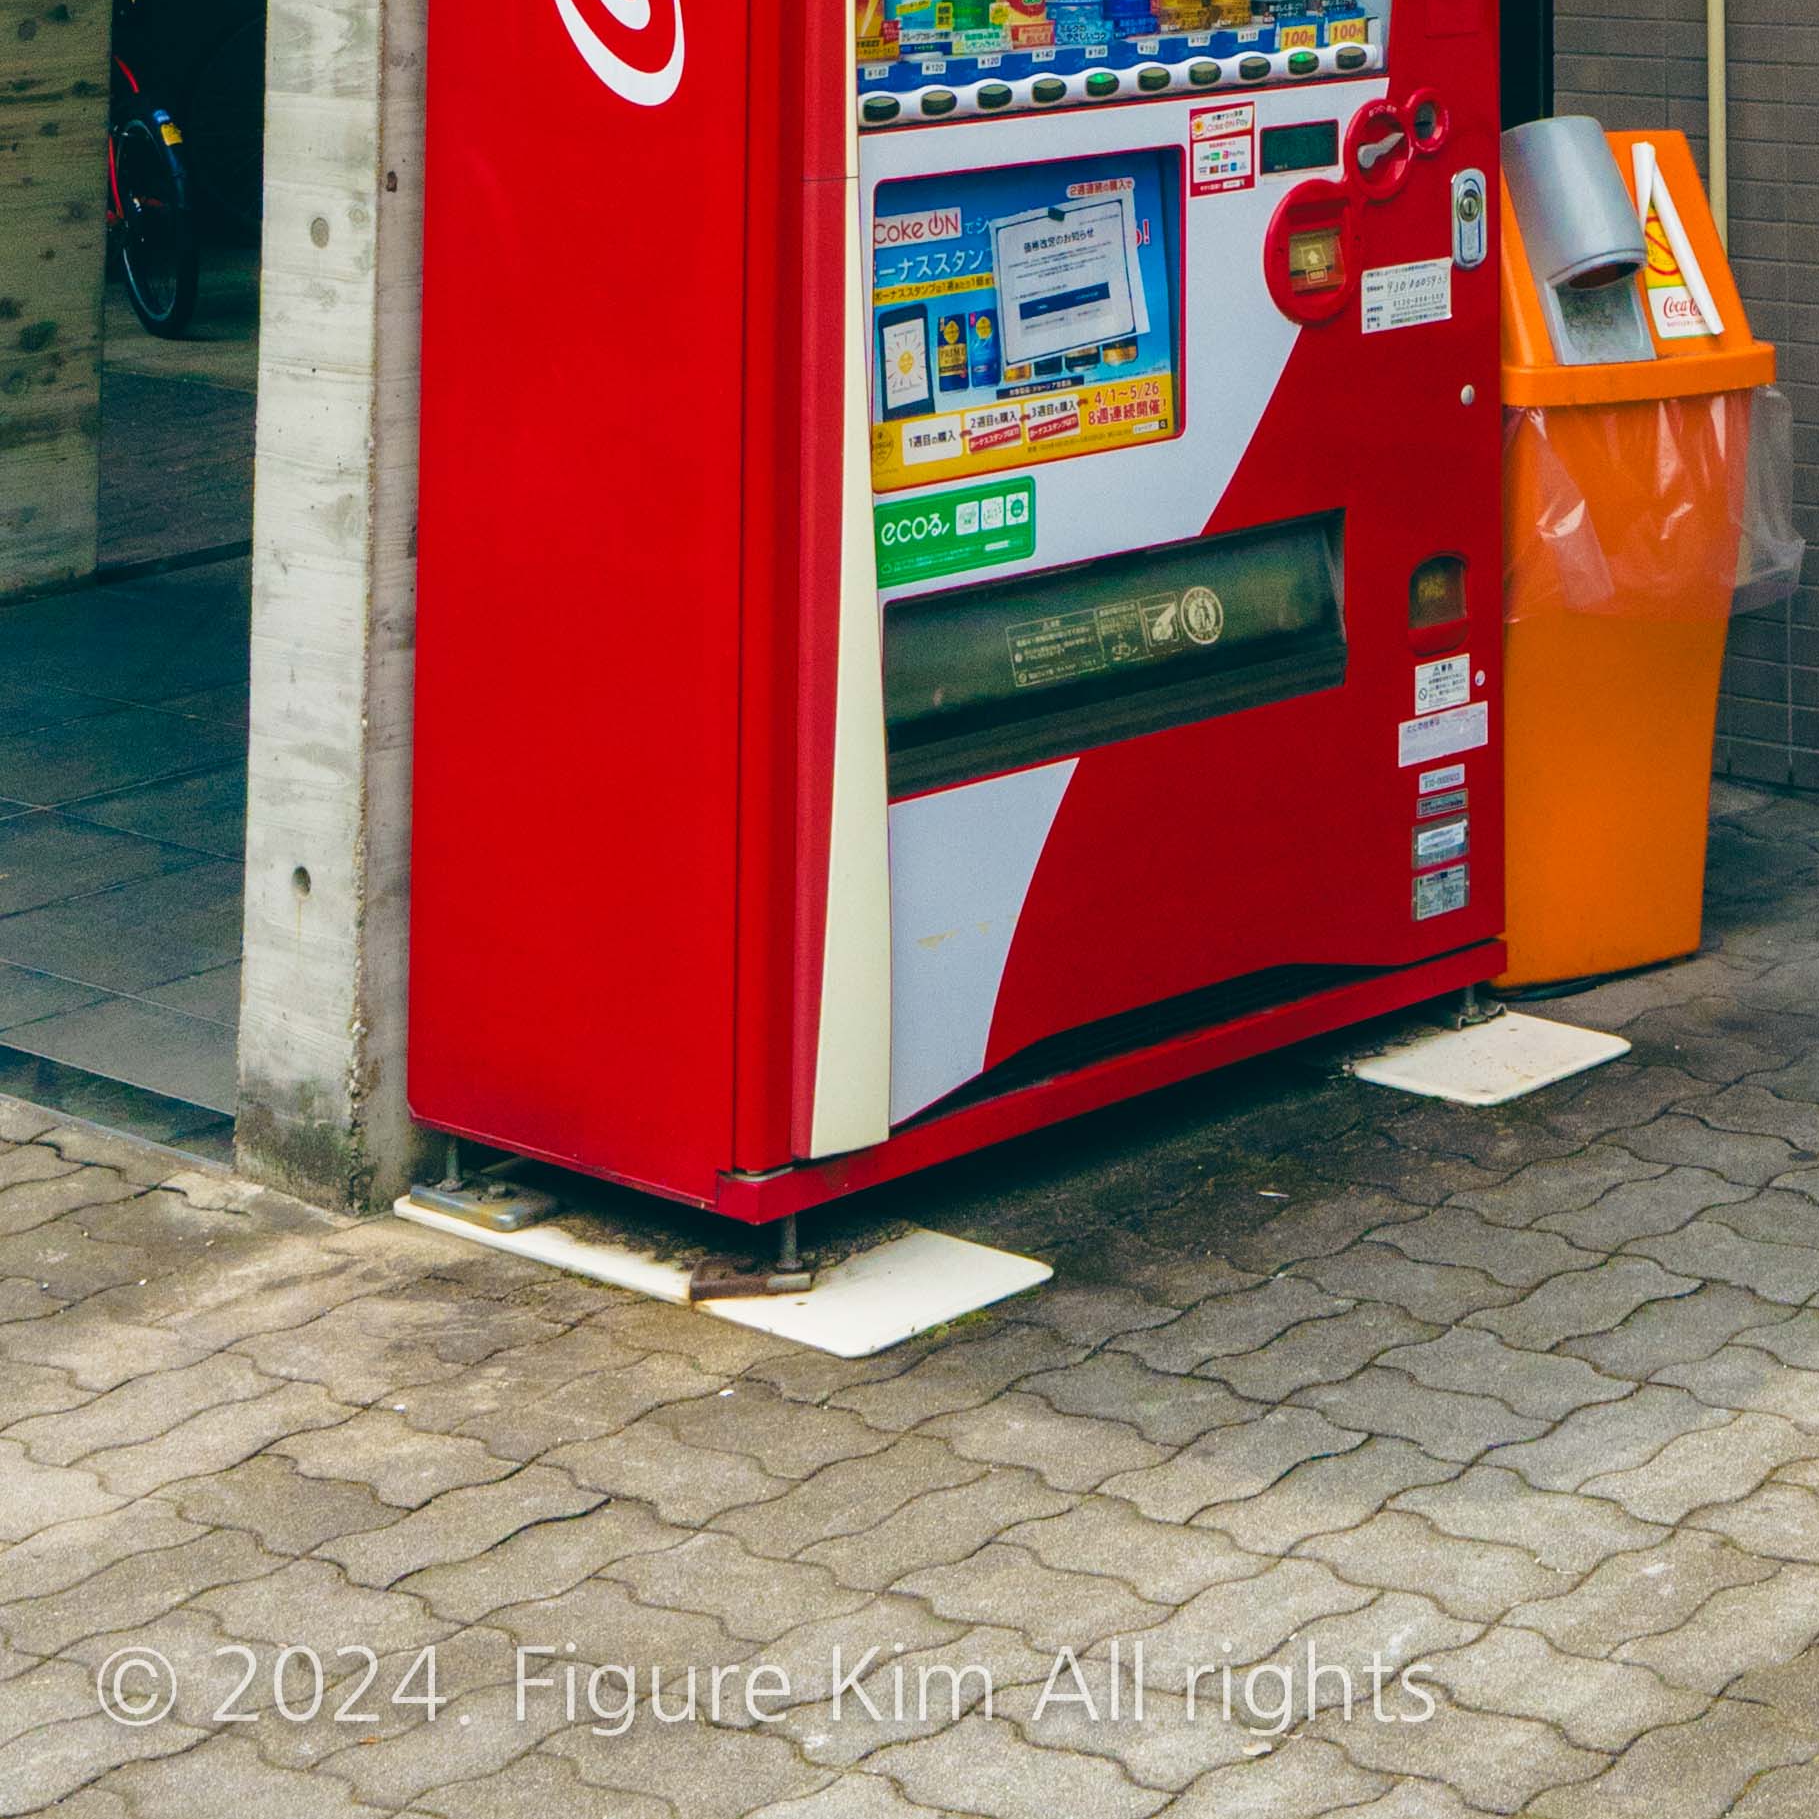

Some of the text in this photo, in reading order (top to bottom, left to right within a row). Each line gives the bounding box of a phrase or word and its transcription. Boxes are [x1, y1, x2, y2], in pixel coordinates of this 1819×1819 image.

[874, 220, 924, 245] Coke
[928, 211, 959, 237] ON
[1023, 227, 1095, 255] 価格改定のお知らせ
[1031, 400, 1077, 418] 3週目も購入
[970, 410, 1018, 429] 2週目も購入
[908, 431, 957, 449] 1週目の購入
